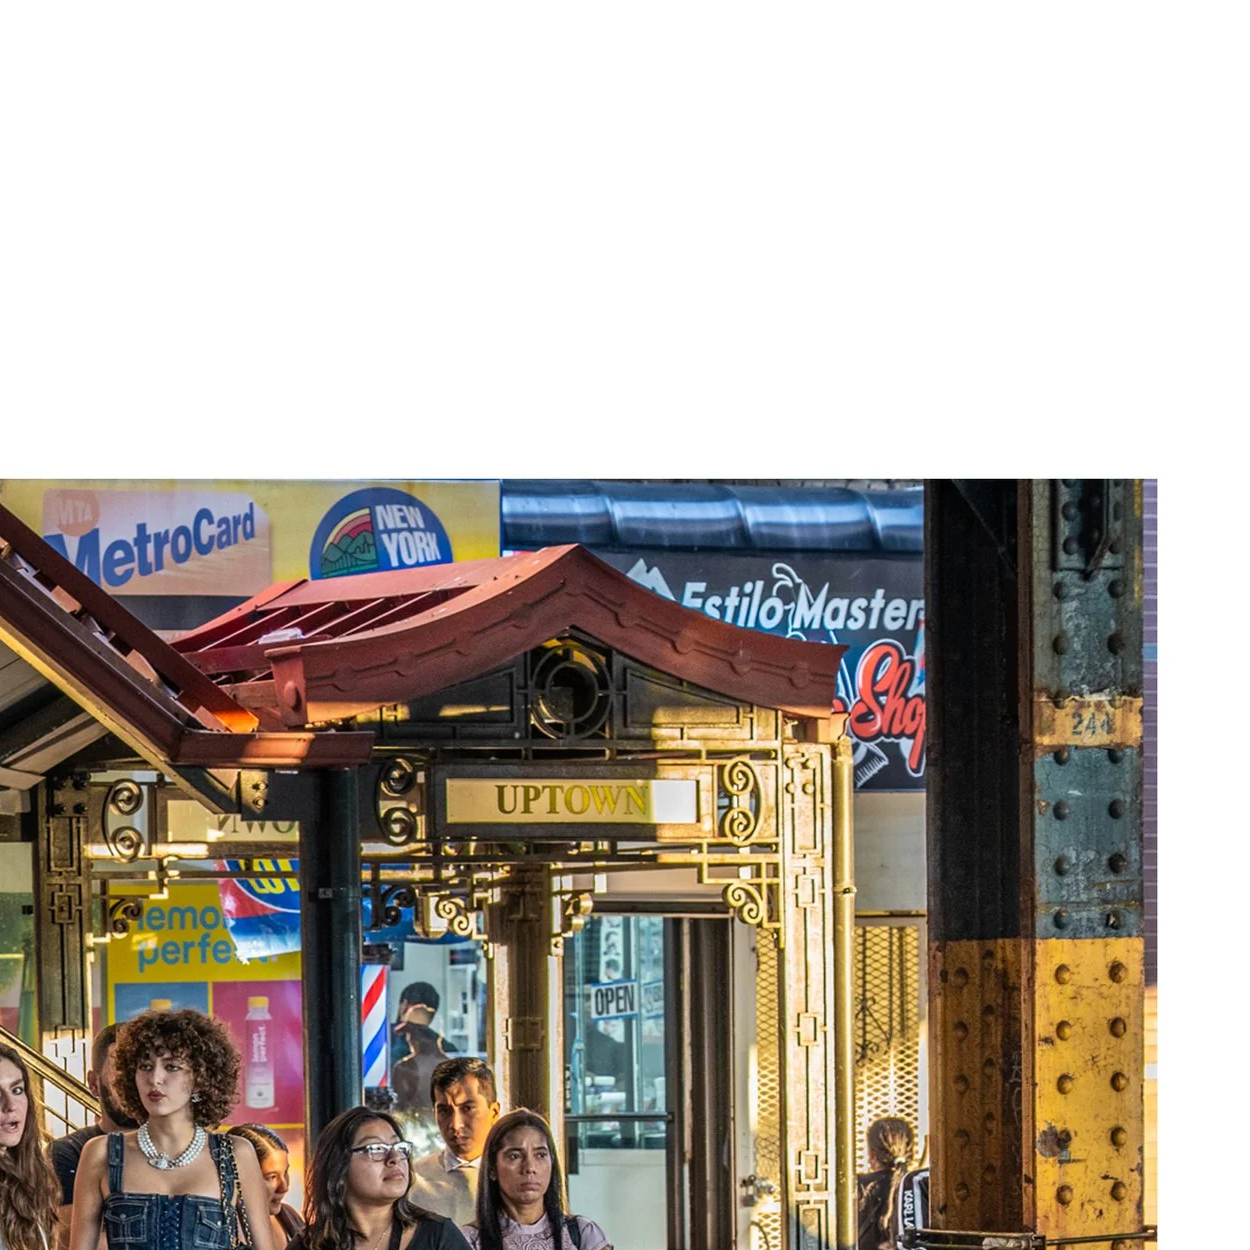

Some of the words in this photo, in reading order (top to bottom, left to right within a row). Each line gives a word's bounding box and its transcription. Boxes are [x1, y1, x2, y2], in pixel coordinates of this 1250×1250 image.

[375, 504, 425, 531] NEW
[43, 502, 256, 588] MetroCard
[381, 531, 442, 568] YORK
[682, 580, 785, 629] Estilo
[495, 784, 649, 816] UPTOWN
[594, 983, 636, 1017] OPEN
